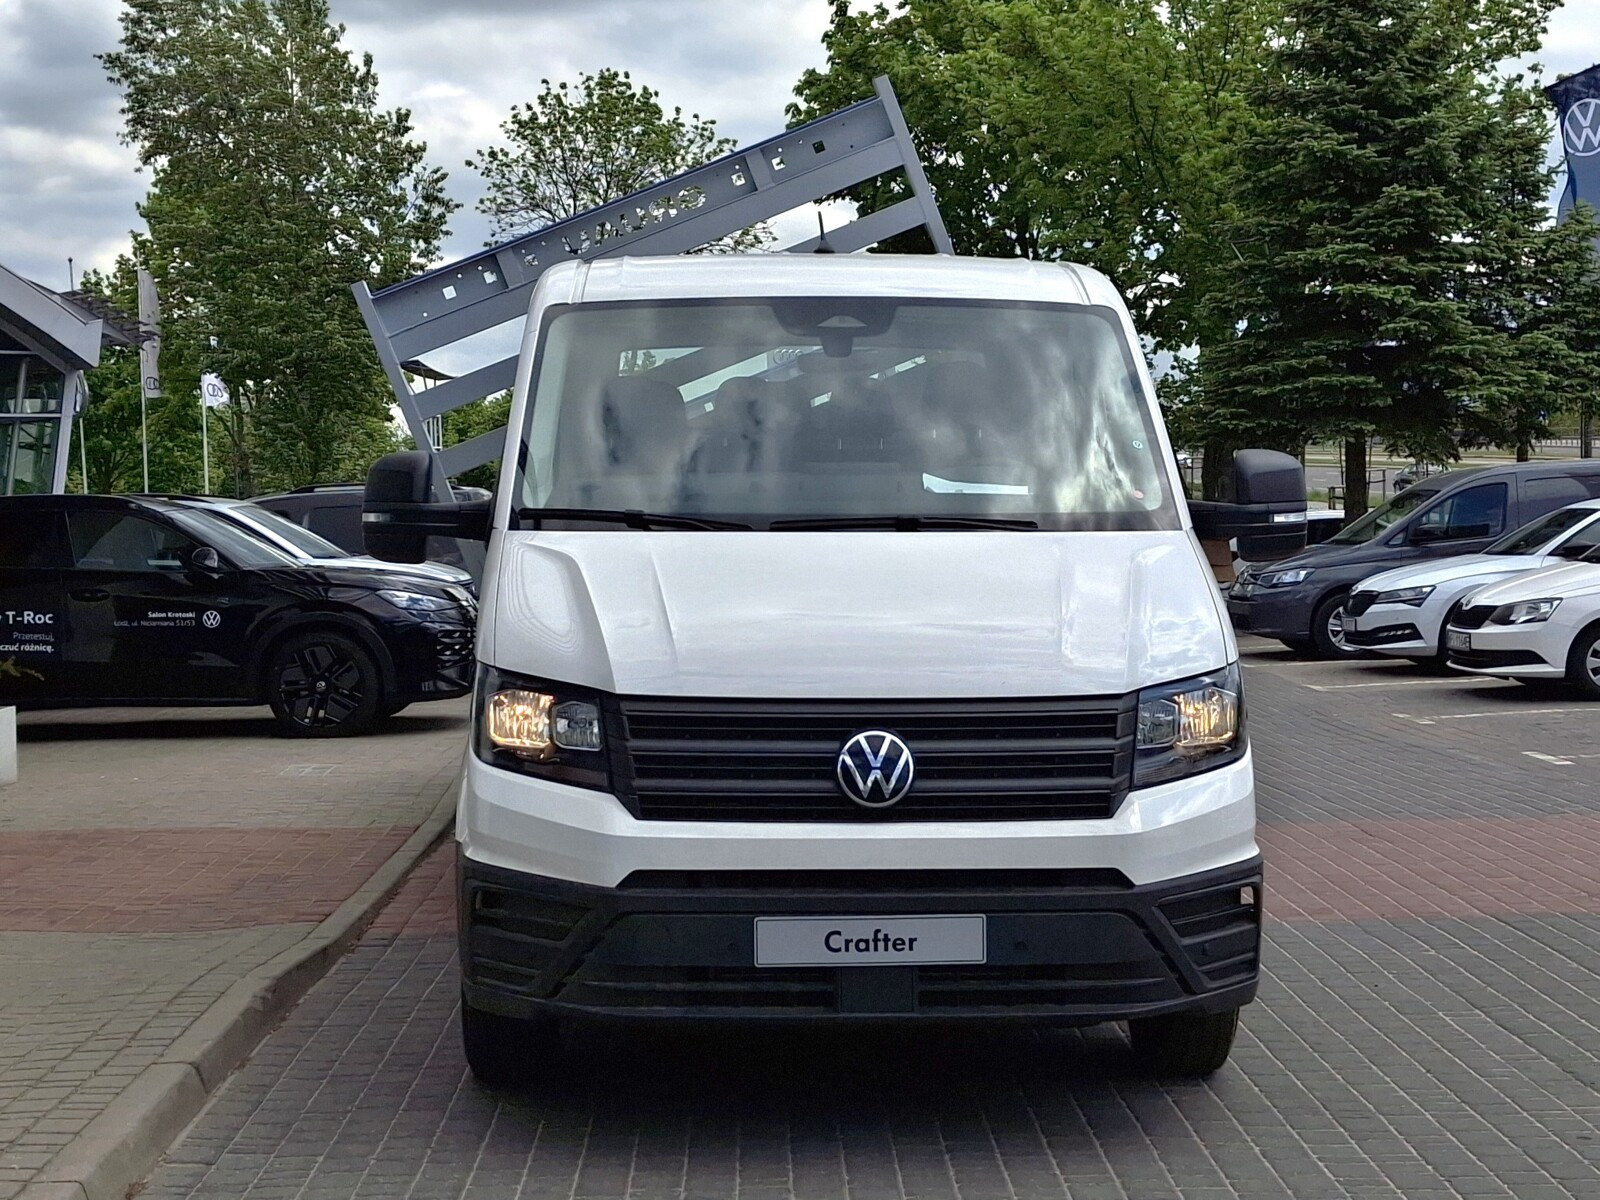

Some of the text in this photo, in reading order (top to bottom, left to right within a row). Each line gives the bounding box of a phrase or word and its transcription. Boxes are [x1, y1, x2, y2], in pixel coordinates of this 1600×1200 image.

[5, 611, 54, 625] T-Roc
[20, 643, 55, 653] różnicę.
[824, 929, 918, 953] Crafter
